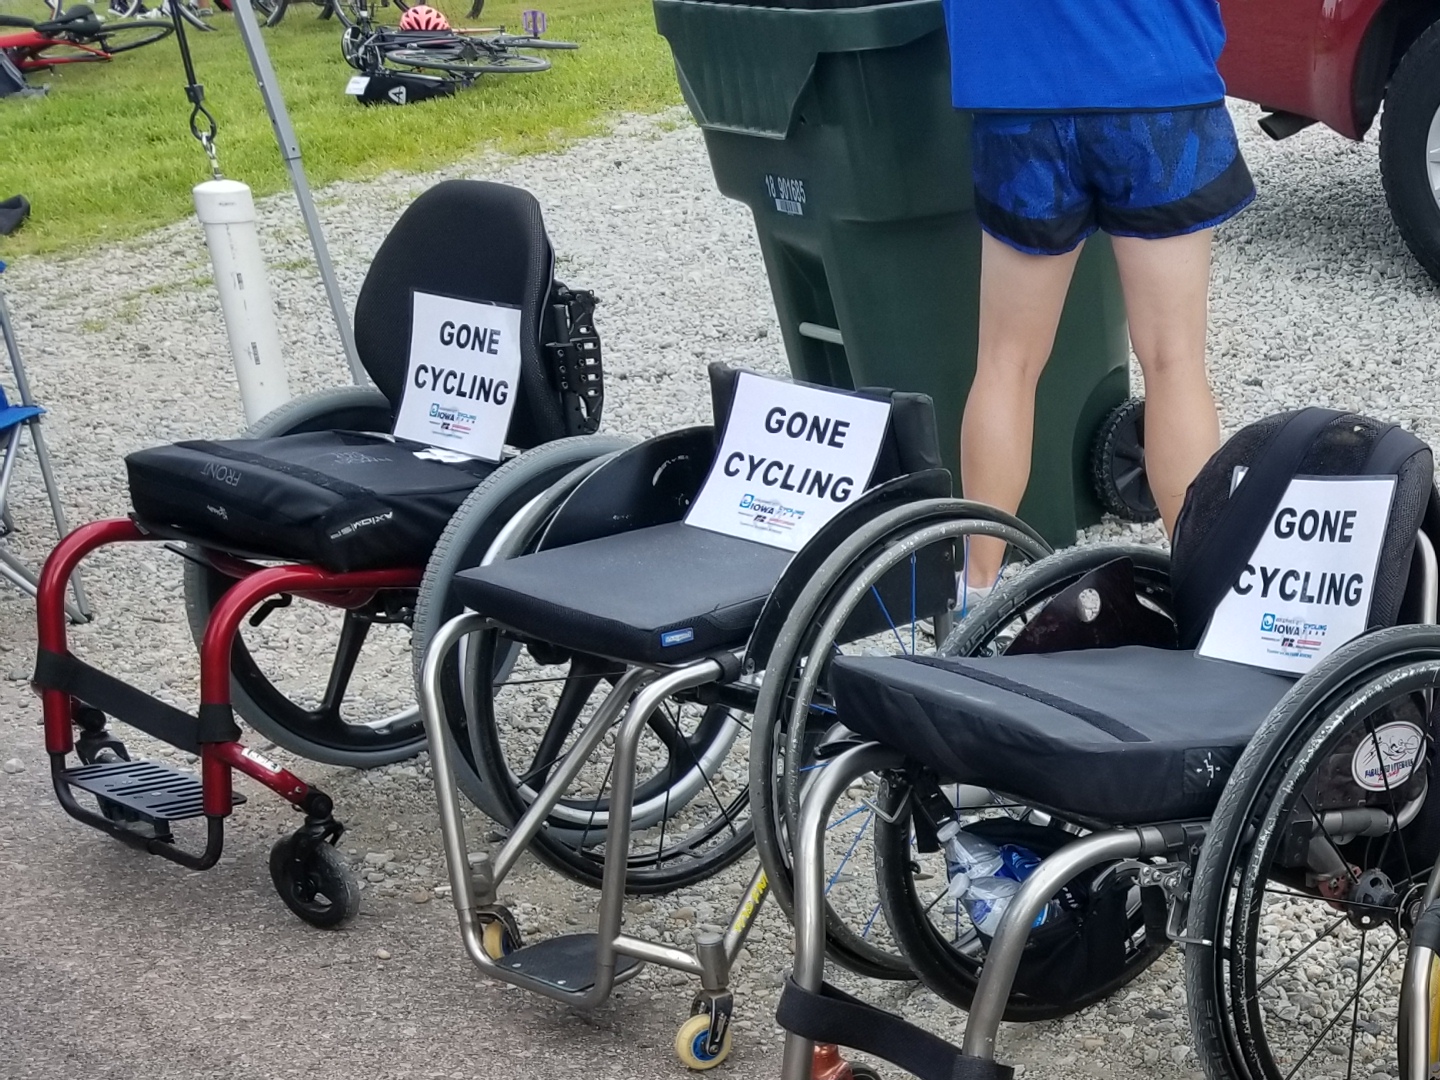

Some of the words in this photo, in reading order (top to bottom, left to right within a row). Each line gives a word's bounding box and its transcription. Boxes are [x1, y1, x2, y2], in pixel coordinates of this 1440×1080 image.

[766, 174, 776, 198] 18
[440, 320, 501, 355] GONE
[414, 364, 509, 405] CYCLING
[764, 406, 850, 449] GONE
[200, 461, 242, 487] FRONT
[723, 451, 853, 503] CYCLING
[750, 503, 775, 515] IOWA
[1273, 507, 1357, 543] GONE
[1232, 563, 1363, 607] CYCLING
[1273, 624, 1300, 636] IOWA
